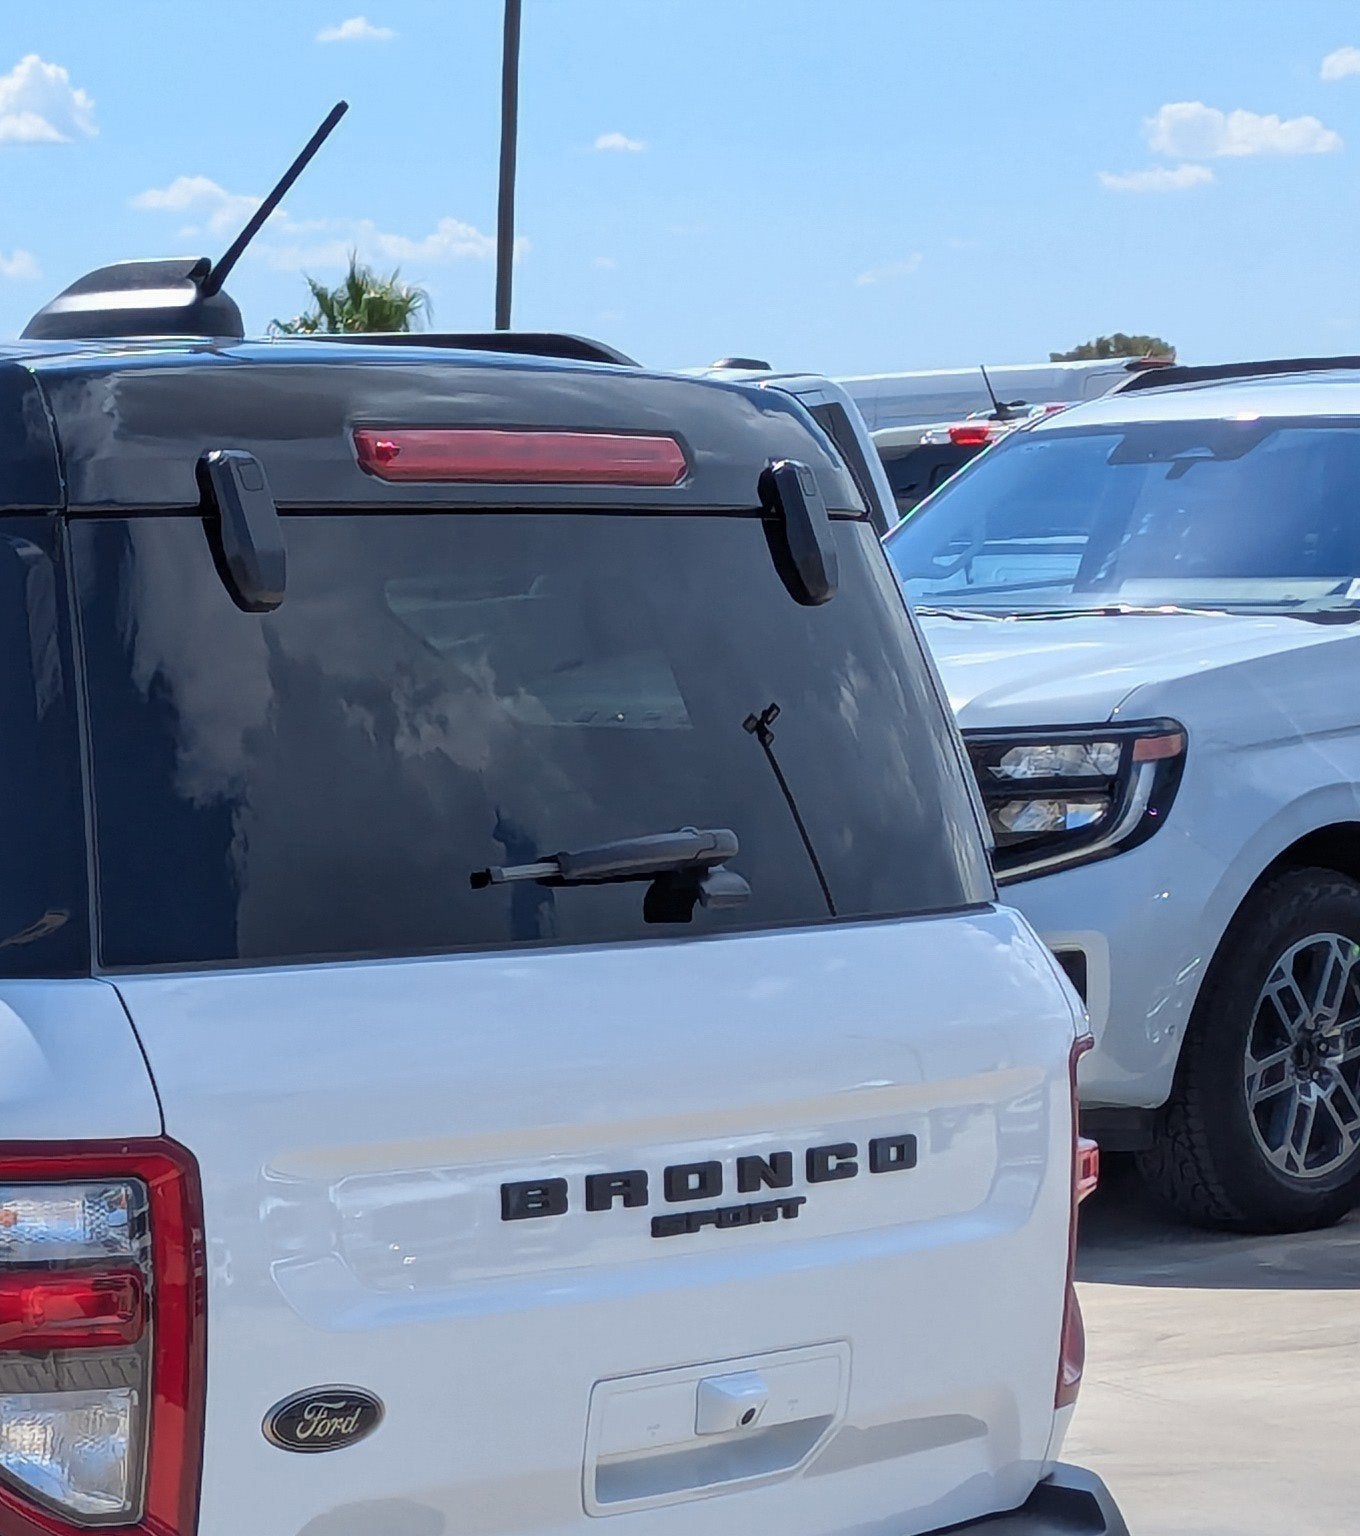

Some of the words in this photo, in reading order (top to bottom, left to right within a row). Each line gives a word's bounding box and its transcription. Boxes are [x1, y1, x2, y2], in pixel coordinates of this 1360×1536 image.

[500, 1133, 918, 1221] BRONCO
[650, 1196, 807, 1238] SPORT
[296, 1401, 362, 1439] Ford
